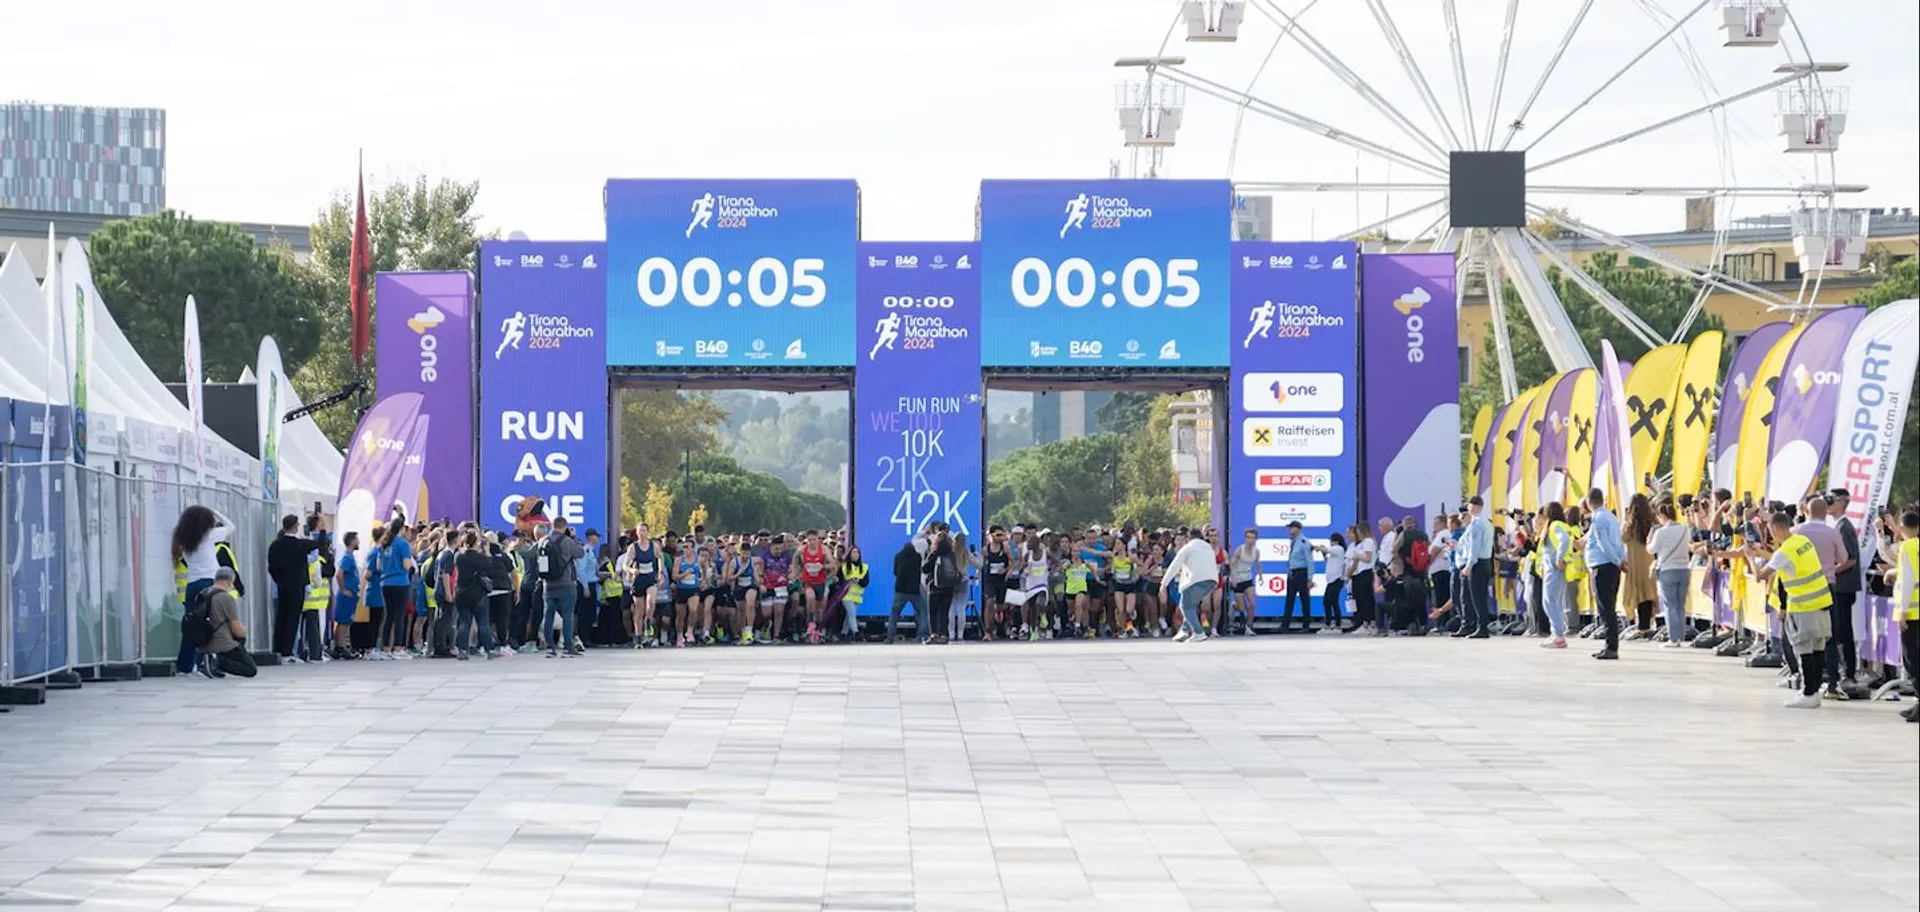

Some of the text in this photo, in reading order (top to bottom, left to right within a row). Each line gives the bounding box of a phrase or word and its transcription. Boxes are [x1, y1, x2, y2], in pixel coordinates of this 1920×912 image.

[718, 195, 754, 207] Tirana
[1092, 195, 1128, 207] Tirana
[718, 206, 778, 217] Marathon
[1092, 206, 1152, 217] Marathon
[717, 217, 747, 228] 2024
[1091, 217, 1121, 228] 2024
[637, 257, 826, 307] 00:05
[1011, 257, 1200, 308] 00:05
[883, 296, 954, 308] 00:00
[1279, 303, 1318, 315] Tirana
[529, 314, 568, 326] Tirana
[903, 315, 942, 327] Tirana
[1279, 314, 1344, 326] Marathon
[530, 325, 593, 337] Marathon
[905, 326, 968, 338] Marathon
[1278, 326, 1310, 338] 2024
[529, 338, 560, 349] 2024
[903, 338, 935, 349] 2024
[1407, 315, 1425, 363] one
[420, 334, 438, 383] one
[1813, 371, 1841, 384] on
[1287, 384, 1318, 396] one
[899, 397, 960, 413] FUN RUN
[501, 411, 584, 440] RUN
[871, 412, 942, 432] WE TOO
[1278, 425, 1335, 436] Raiffeisen
[378, 437, 405, 451] one
[901, 429, 944, 457] 10K
[514, 452, 570, 482] AS
[876, 456, 931, 492] 21K
[1271, 476, 1312, 485] SPAR
[890, 490, 970, 536] 42K
